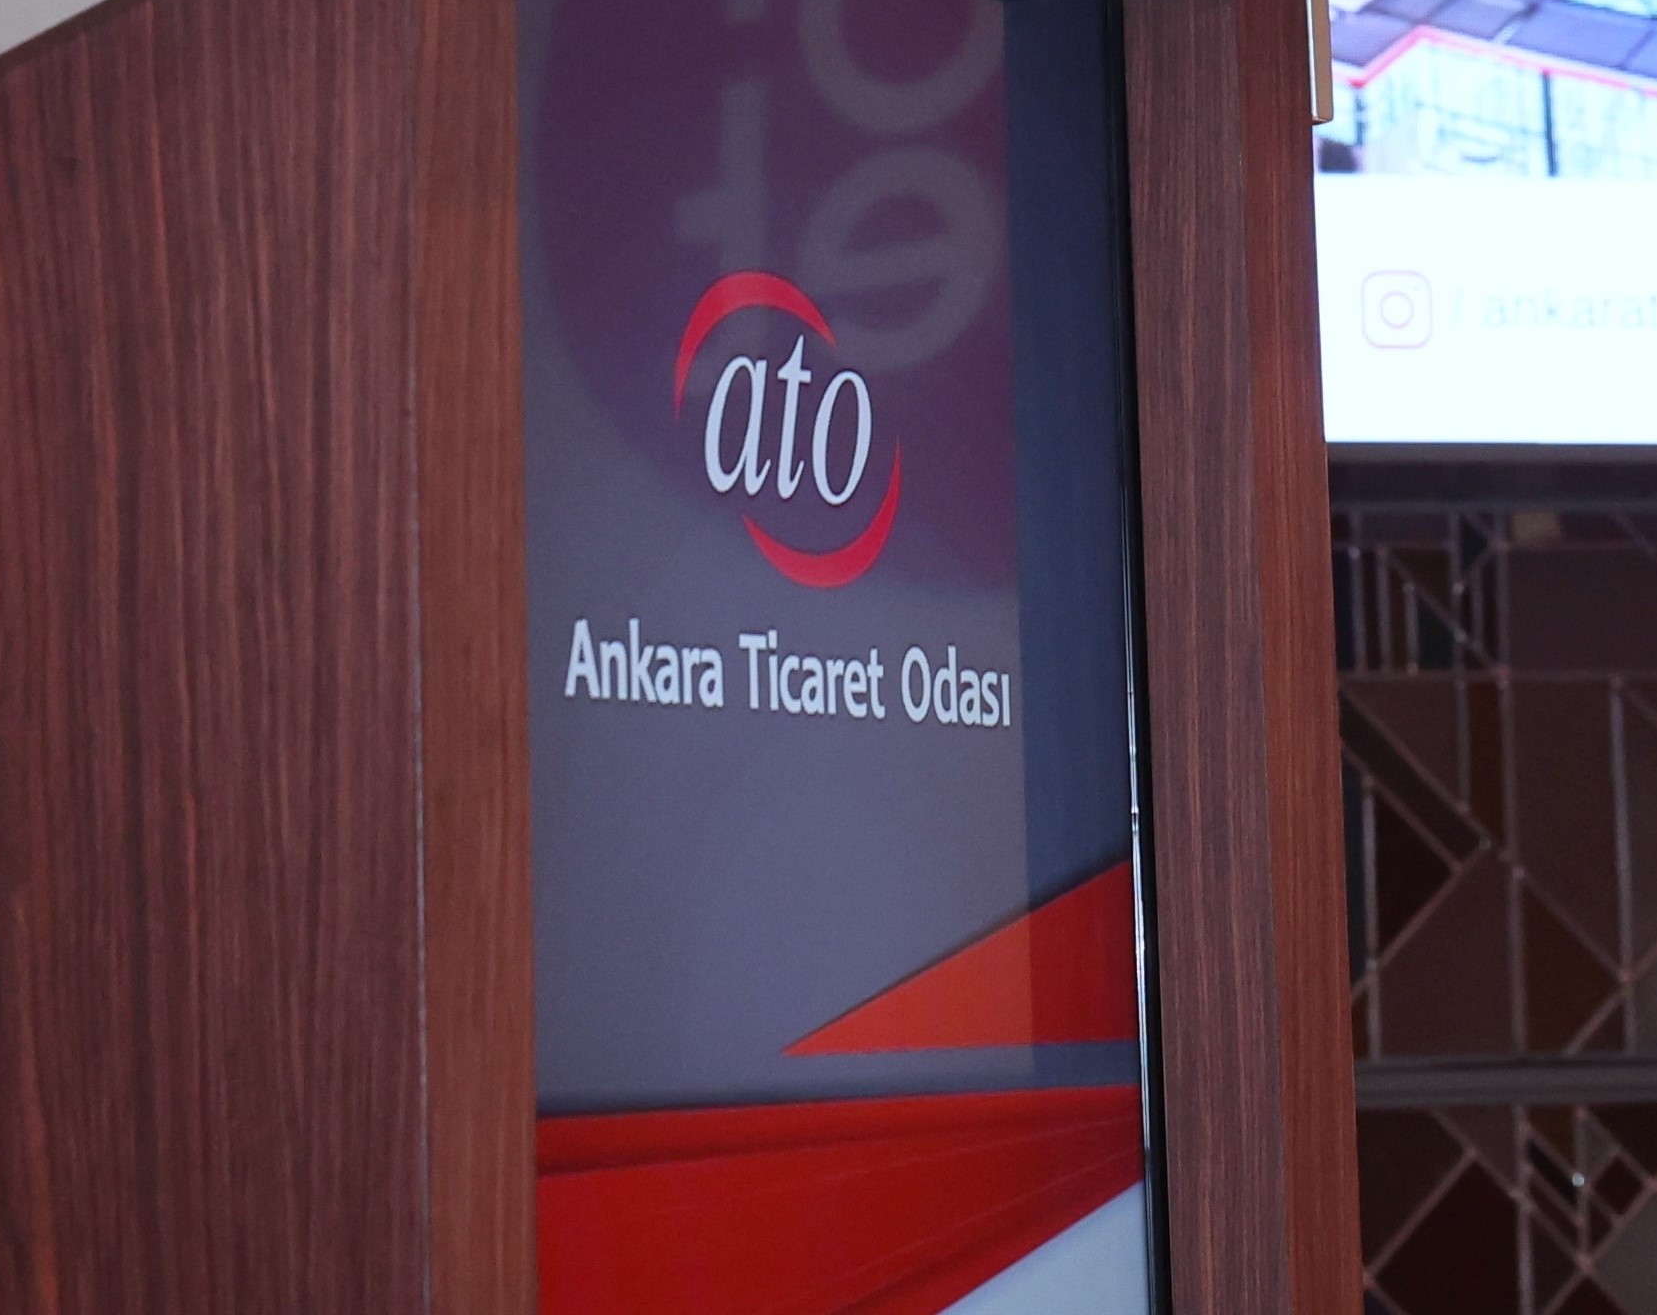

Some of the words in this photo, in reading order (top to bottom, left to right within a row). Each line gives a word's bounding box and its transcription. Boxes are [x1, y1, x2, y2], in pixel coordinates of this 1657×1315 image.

[703, 334, 873, 506] ato
[564, 617, 725, 709] Ankara
[737, 628, 887, 720] Ticaret
[900, 644, 1012, 728] Odası
